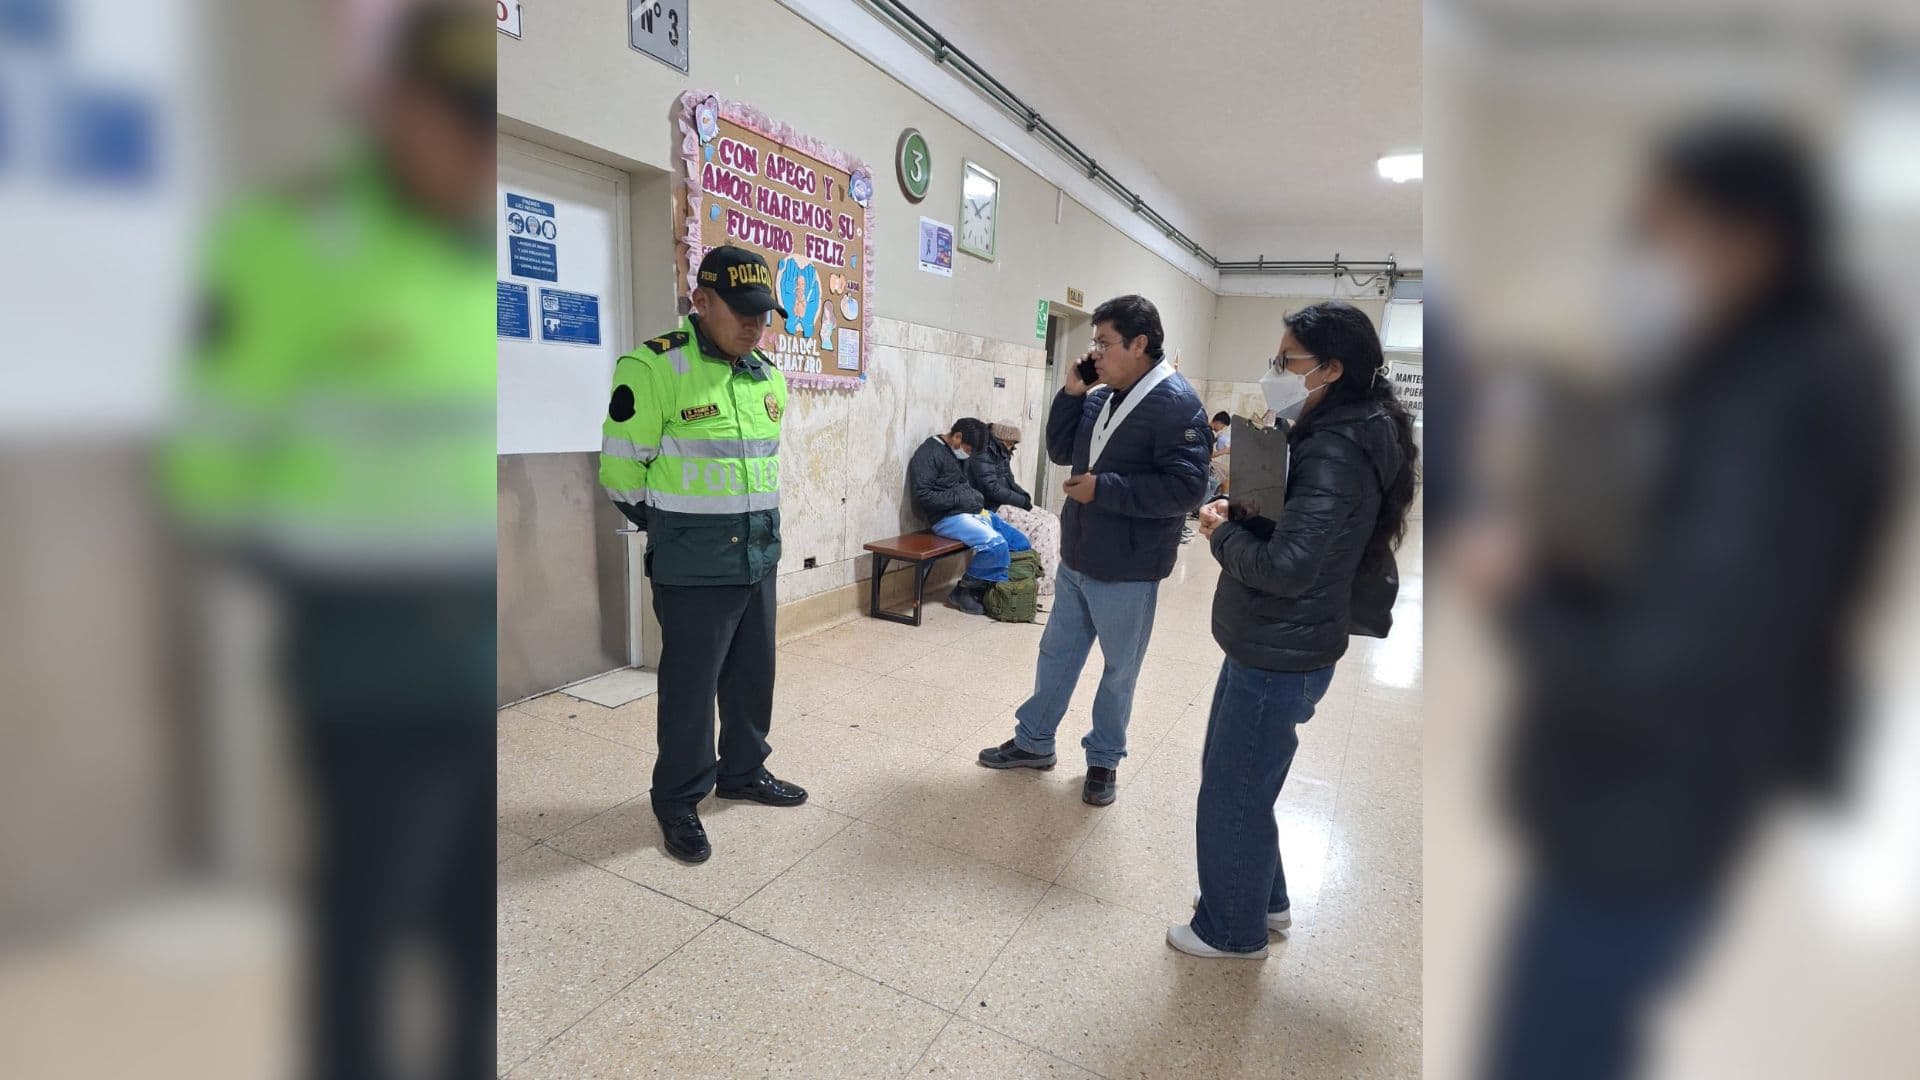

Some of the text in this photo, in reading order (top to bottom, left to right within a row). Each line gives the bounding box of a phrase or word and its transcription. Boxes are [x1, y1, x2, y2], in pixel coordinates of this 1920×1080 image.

[669, 9, 679, 47] 3
[719, 138, 834, 200] CON APEGO Y
[910, 149, 923, 182] 3
[702, 163, 855, 240] AMOR HAREMOS SU
[726, 209, 845, 267] FUTURO FELIZ
[1395, 373, 1423, 384] MANTE
